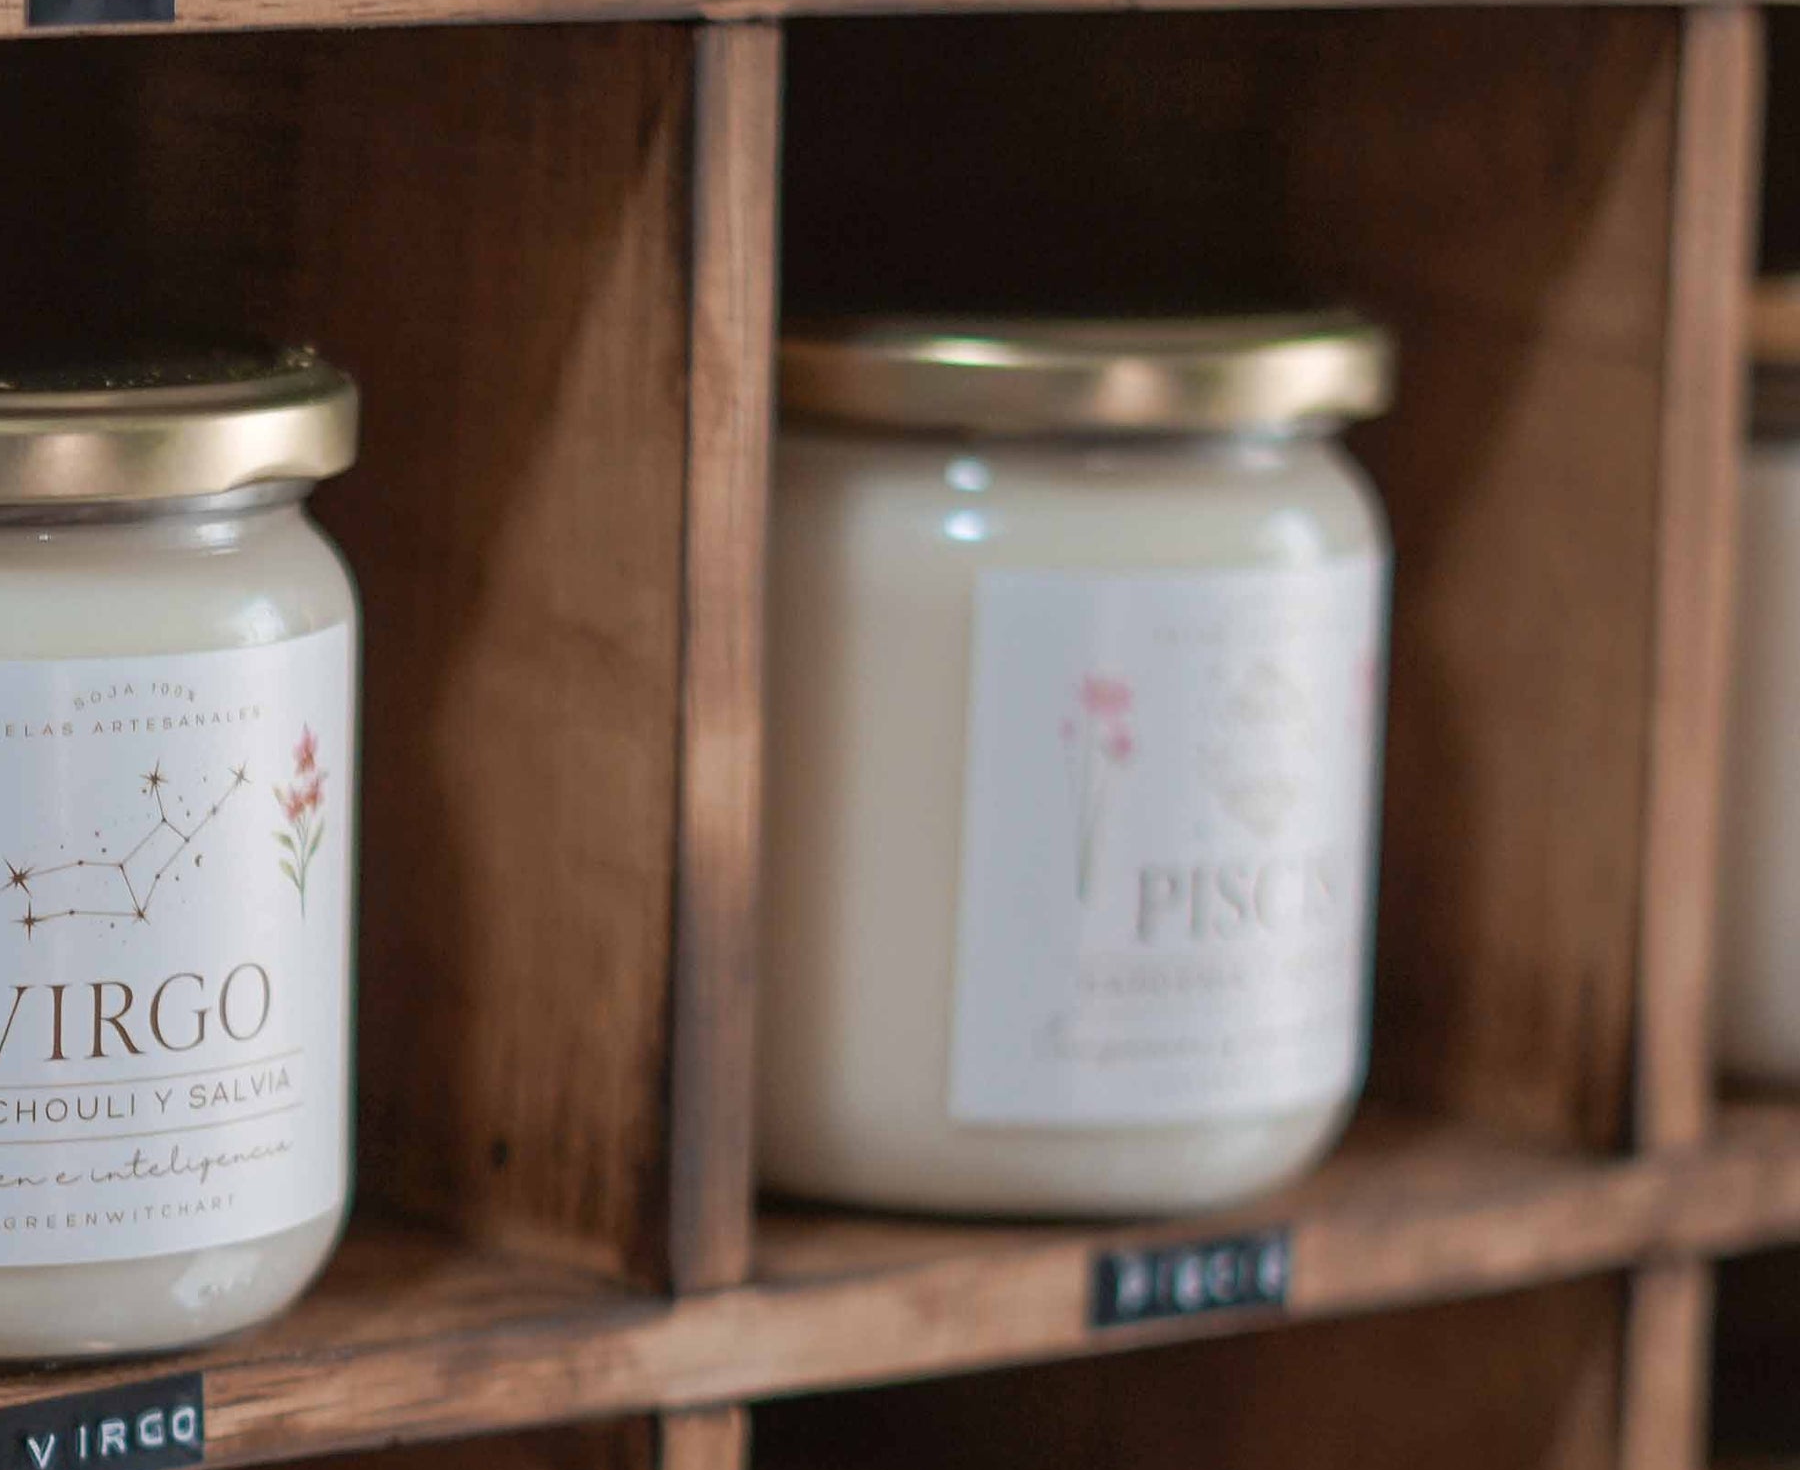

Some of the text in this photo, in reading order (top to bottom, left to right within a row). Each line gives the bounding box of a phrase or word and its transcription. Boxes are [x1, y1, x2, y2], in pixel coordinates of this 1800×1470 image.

[73, 682, 135, 711] SOJA
[91, 704, 261, 735] ARTESANALES
[154, 1088, 174, 1115] Y
[188, 1066, 292, 1111] SALVIA
[55, 1168, 84, 1187] e
[88, 1140, 294, 1186] inteligencia
[2, 1192, 236, 1231] GREENWITCHART
[26, 1404, 197, 1470] VIRGO
